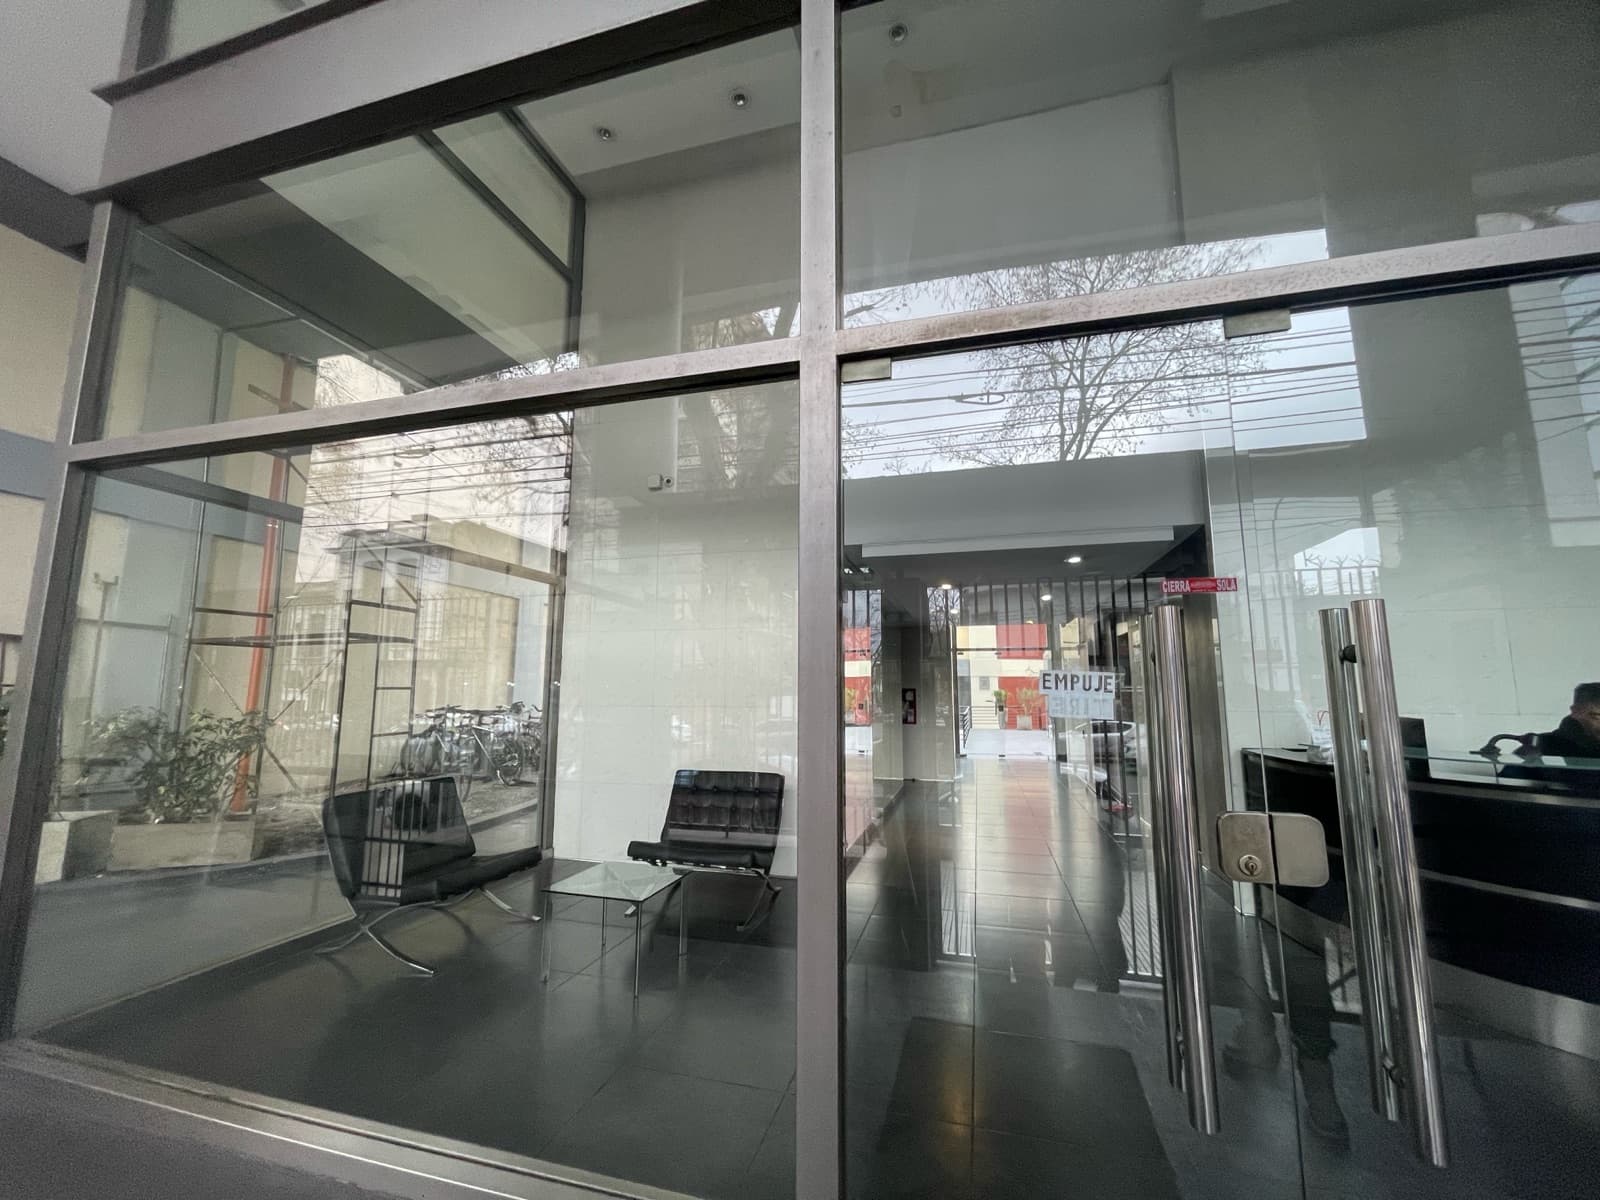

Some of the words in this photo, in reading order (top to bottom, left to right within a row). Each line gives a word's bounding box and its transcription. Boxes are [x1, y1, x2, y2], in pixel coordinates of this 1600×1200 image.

[1162, 580, 1191, 593] CIERRA
[1216, 578, 1237, 591] SOLA
[1042, 673, 1113, 693] EMPUJE
